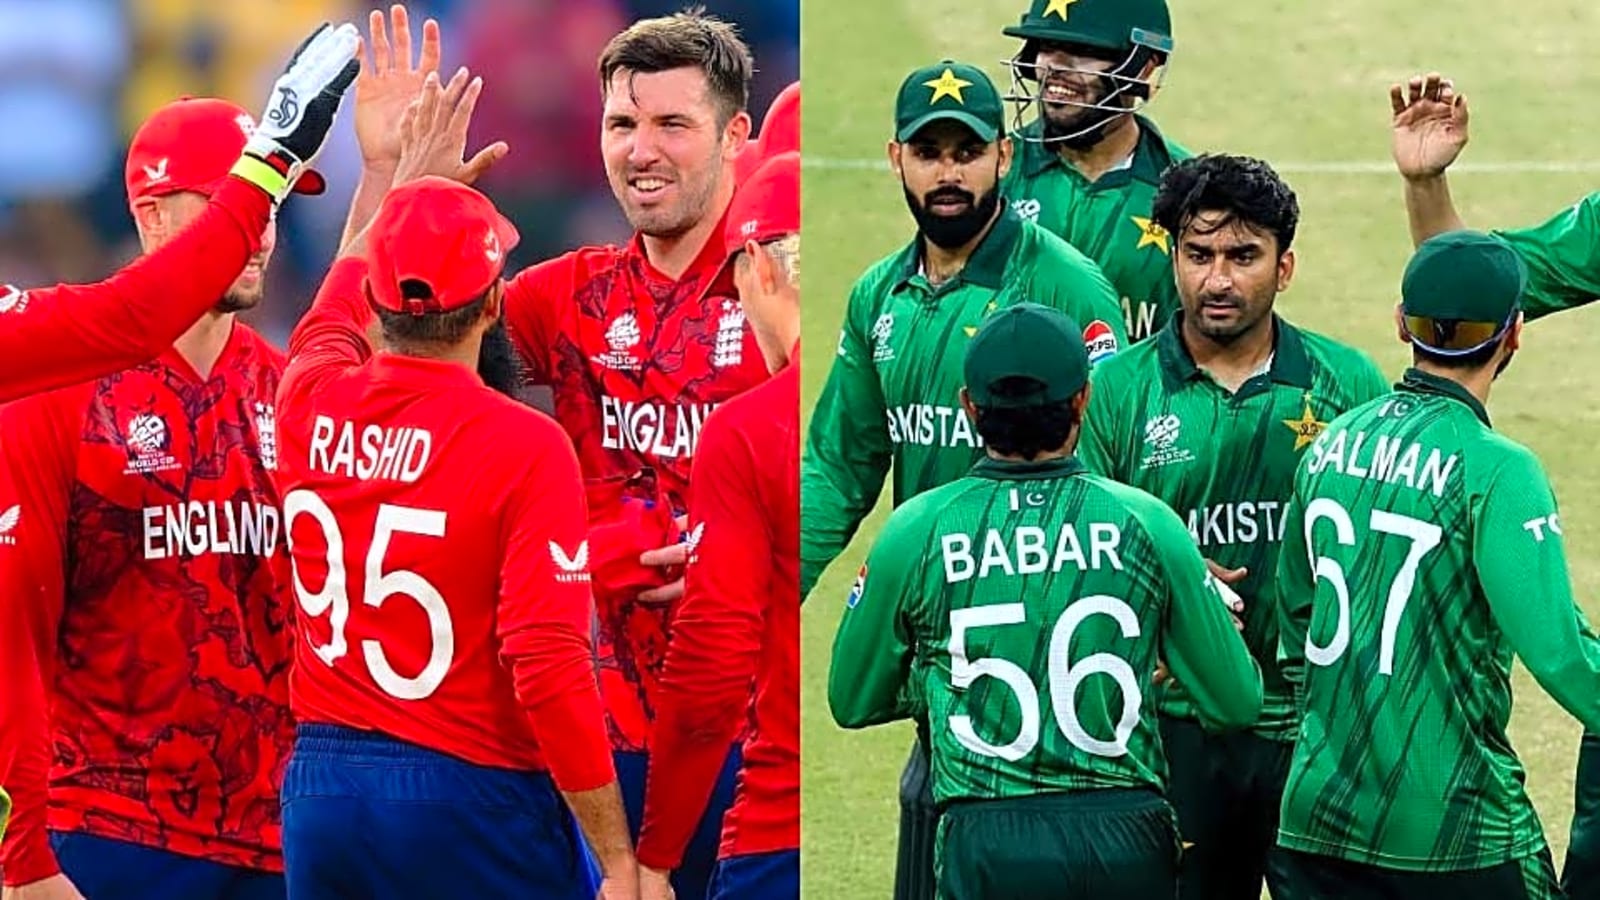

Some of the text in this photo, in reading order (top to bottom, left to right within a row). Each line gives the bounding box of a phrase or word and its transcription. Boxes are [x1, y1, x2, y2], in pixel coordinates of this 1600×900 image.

[309, 414, 432, 483] RASHID
[601, 394, 720, 458] ENGLAN
[1307, 428, 1458, 498] SALMAN
[144, 500, 279, 559] ENGLAND
[941, 523, 1124, 584] BABAR
[283, 489, 454, 700] 95
[1304, 497, 1442, 676] 67
[947, 595, 1142, 762] 56
